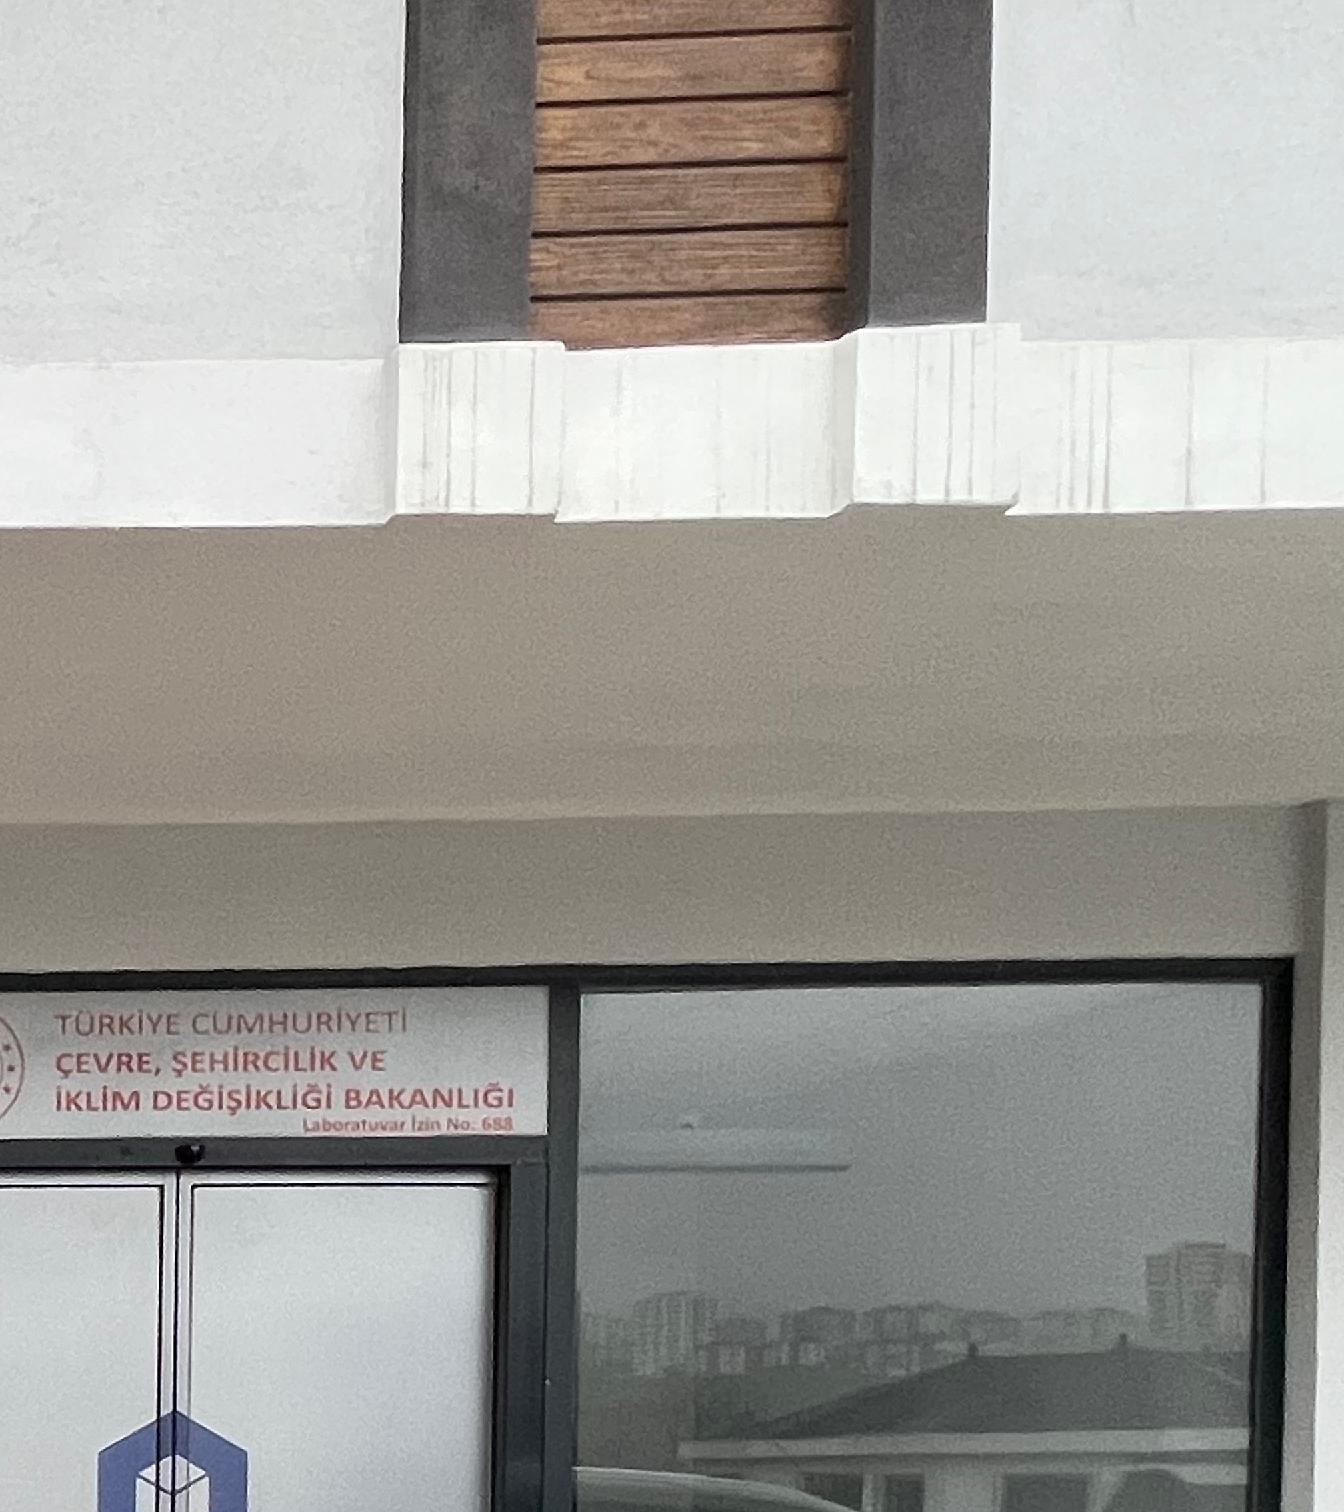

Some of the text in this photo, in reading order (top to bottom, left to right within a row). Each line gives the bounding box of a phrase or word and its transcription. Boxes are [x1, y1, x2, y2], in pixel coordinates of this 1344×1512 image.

[54, 1007, 407, 1036] TÜRKİYE CUMHURİYETİ
[55, 1045, 387, 1079] ÇEVRE, ŞEHİRCİLİK VE
[56, 1081, 514, 1116] İKLİM DEĞİŞİKLİĞİ BAKANLIĞI
[303, 1118, 406, 1132] Laboratuvar
